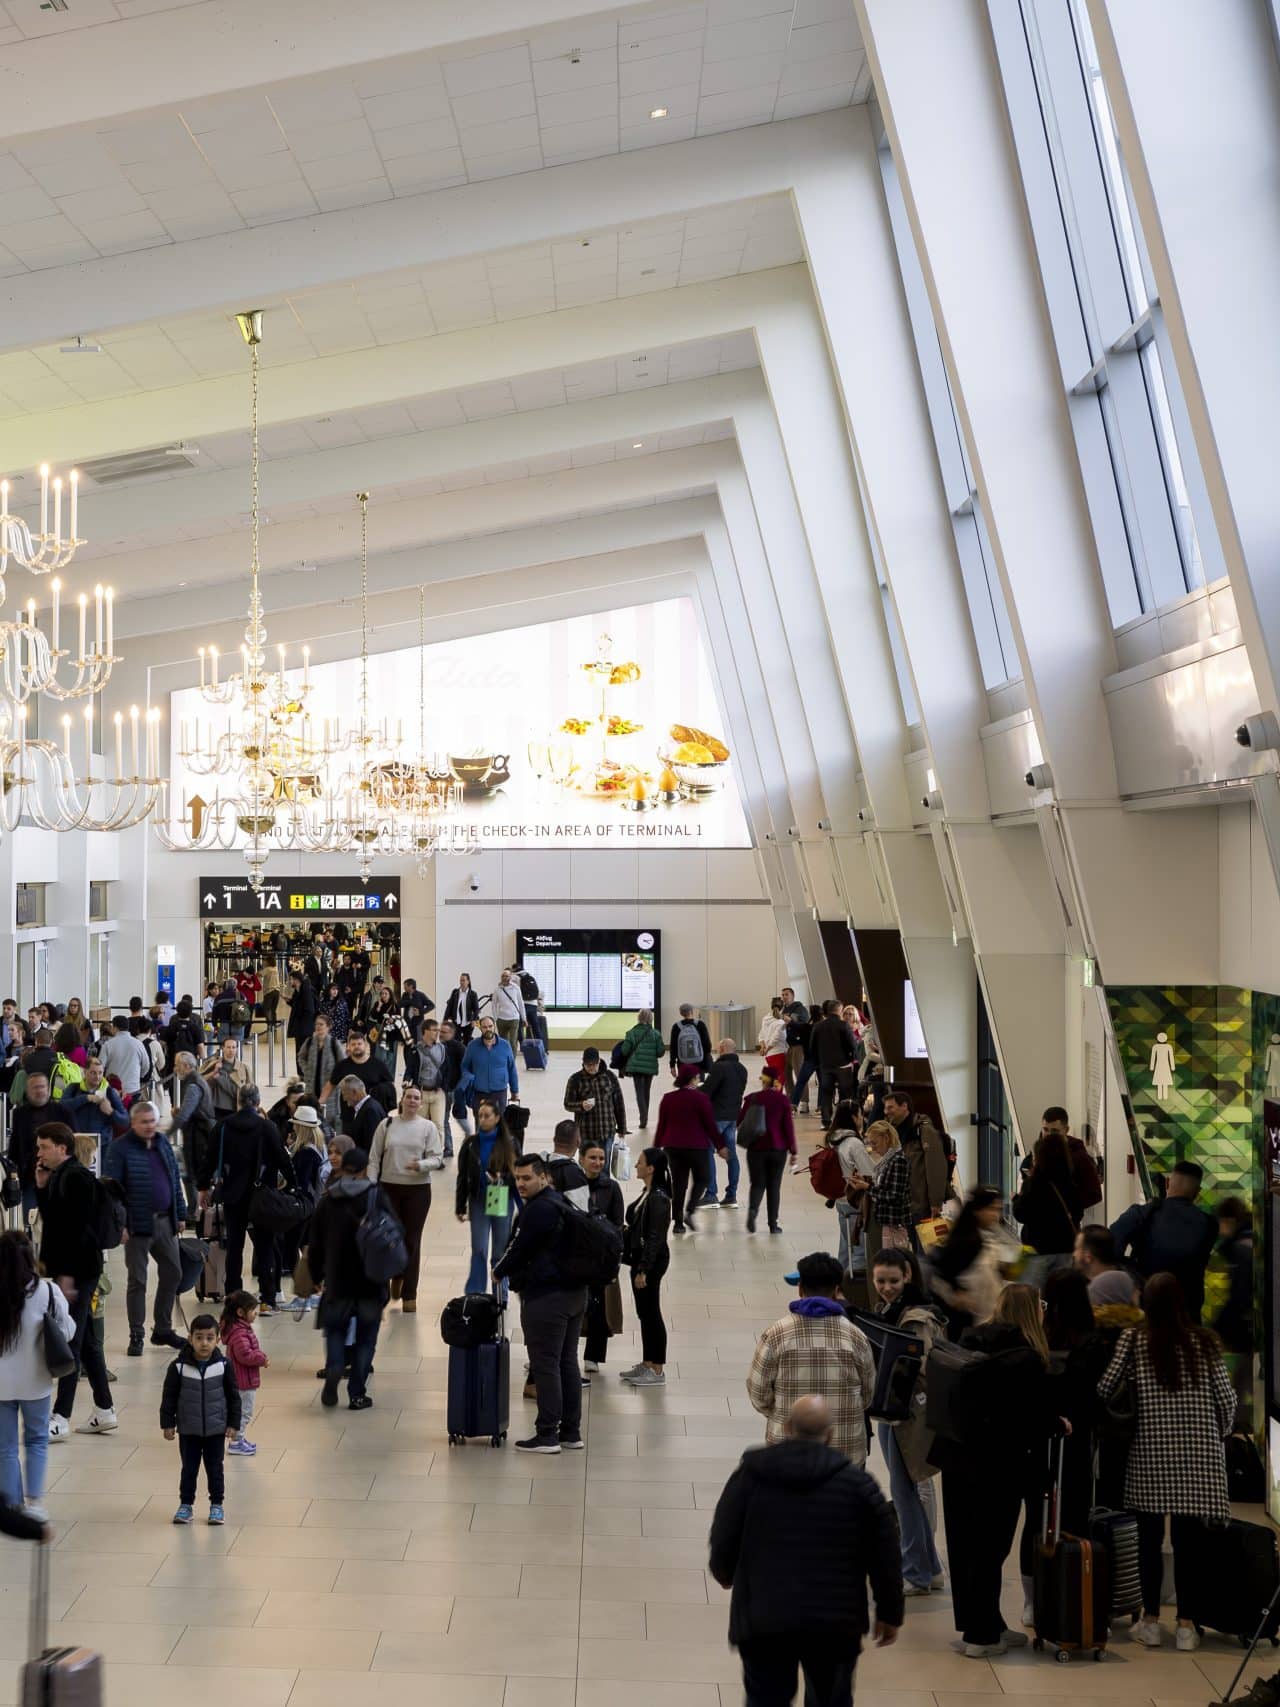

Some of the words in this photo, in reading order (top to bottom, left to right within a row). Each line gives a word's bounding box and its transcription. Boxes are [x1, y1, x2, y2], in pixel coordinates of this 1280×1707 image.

[482, 825, 550, 837] CHECK-IN
[555, 825, 591, 837] AREA
[596, 825, 613, 837] OF
[619, 825, 692, 837] TERMINAL
[695, 825, 703, 837] 1
[223, 892, 232, 909] 1
[257, 892, 282, 909] 1A
